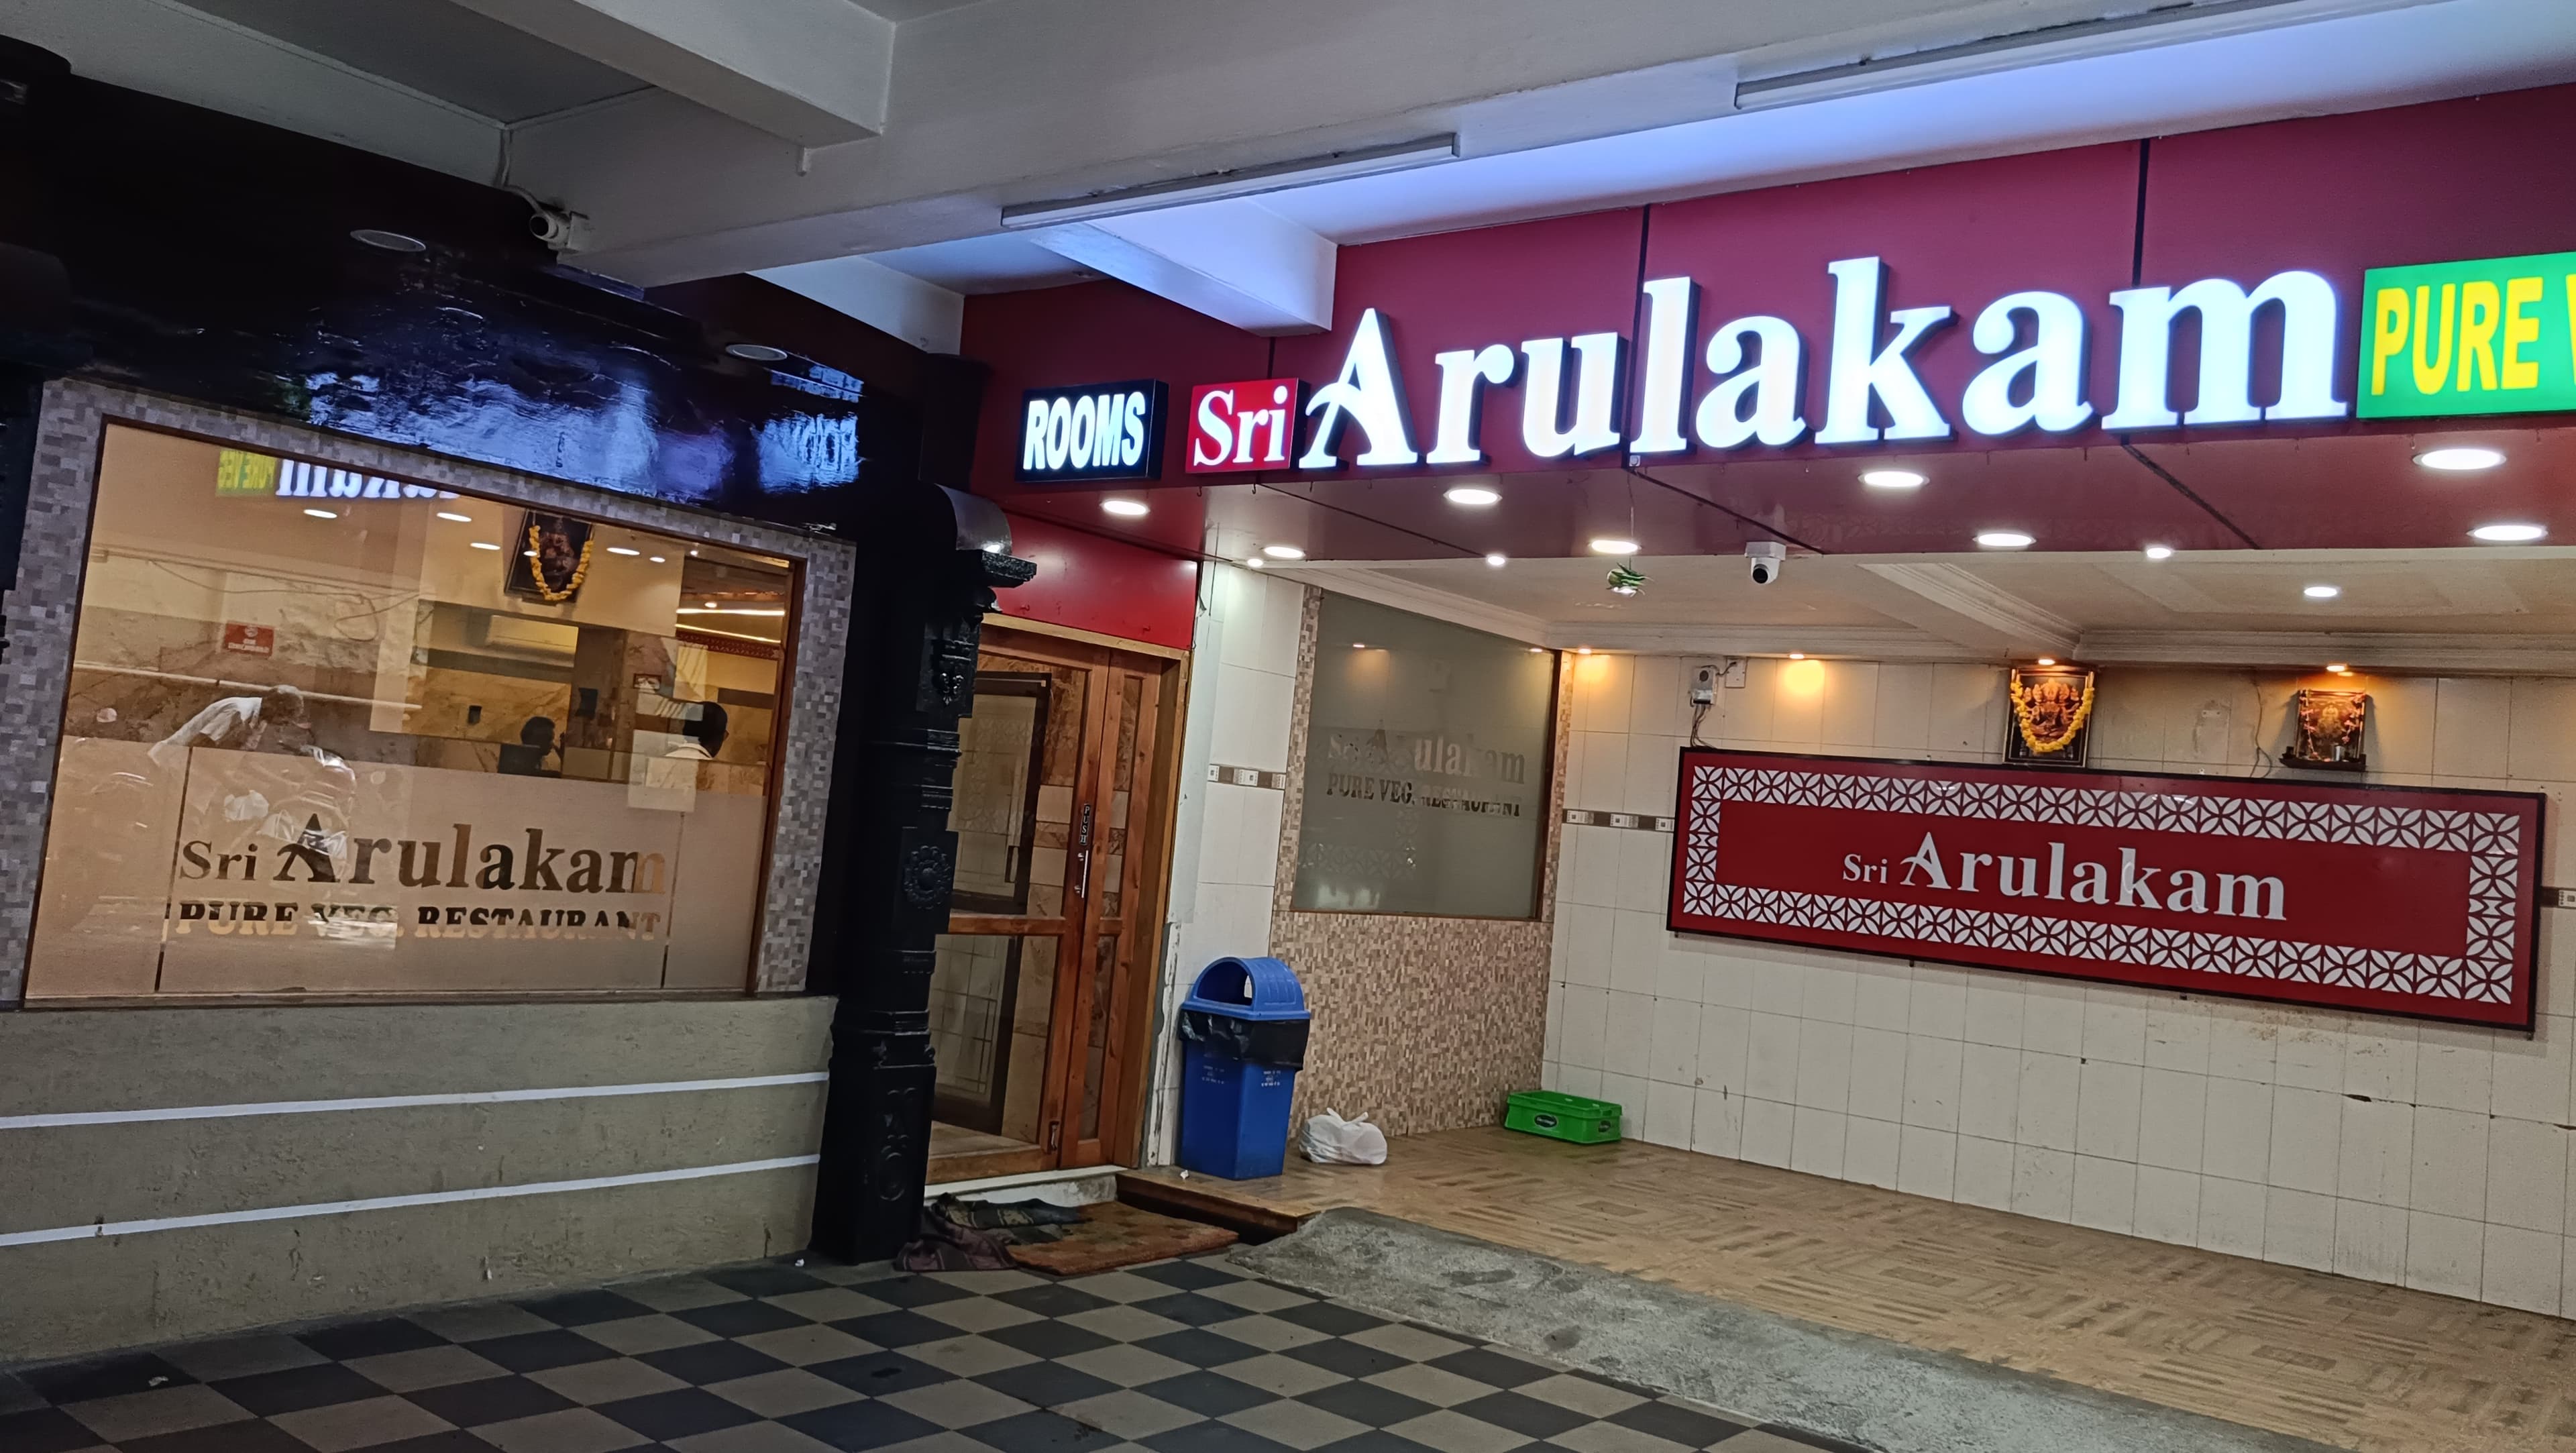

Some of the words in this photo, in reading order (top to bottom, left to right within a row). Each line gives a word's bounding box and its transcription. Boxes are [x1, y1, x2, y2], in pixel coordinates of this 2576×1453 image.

[1193, 385, 1289, 467] Sri
[1299, 256, 2348, 469] Arulakam
[2370, 276, 2543, 395] PURE
[1022, 391, 1146, 470] ROOMS
[1079, 806, 1091, 843] PUSH
[1326, 772, 1375, 800] PURE
[1379, 779, 1415, 806] VEG.
[180, 839, 259, 881] Sri
[273, 813, 666, 894] Arulakam
[1843, 854, 1888, 883] Sri
[1899, 831, 2286, 921] Arulakam
[175, 901, 298, 936] PURE
[415, 906, 661, 941] RESTAURANT
